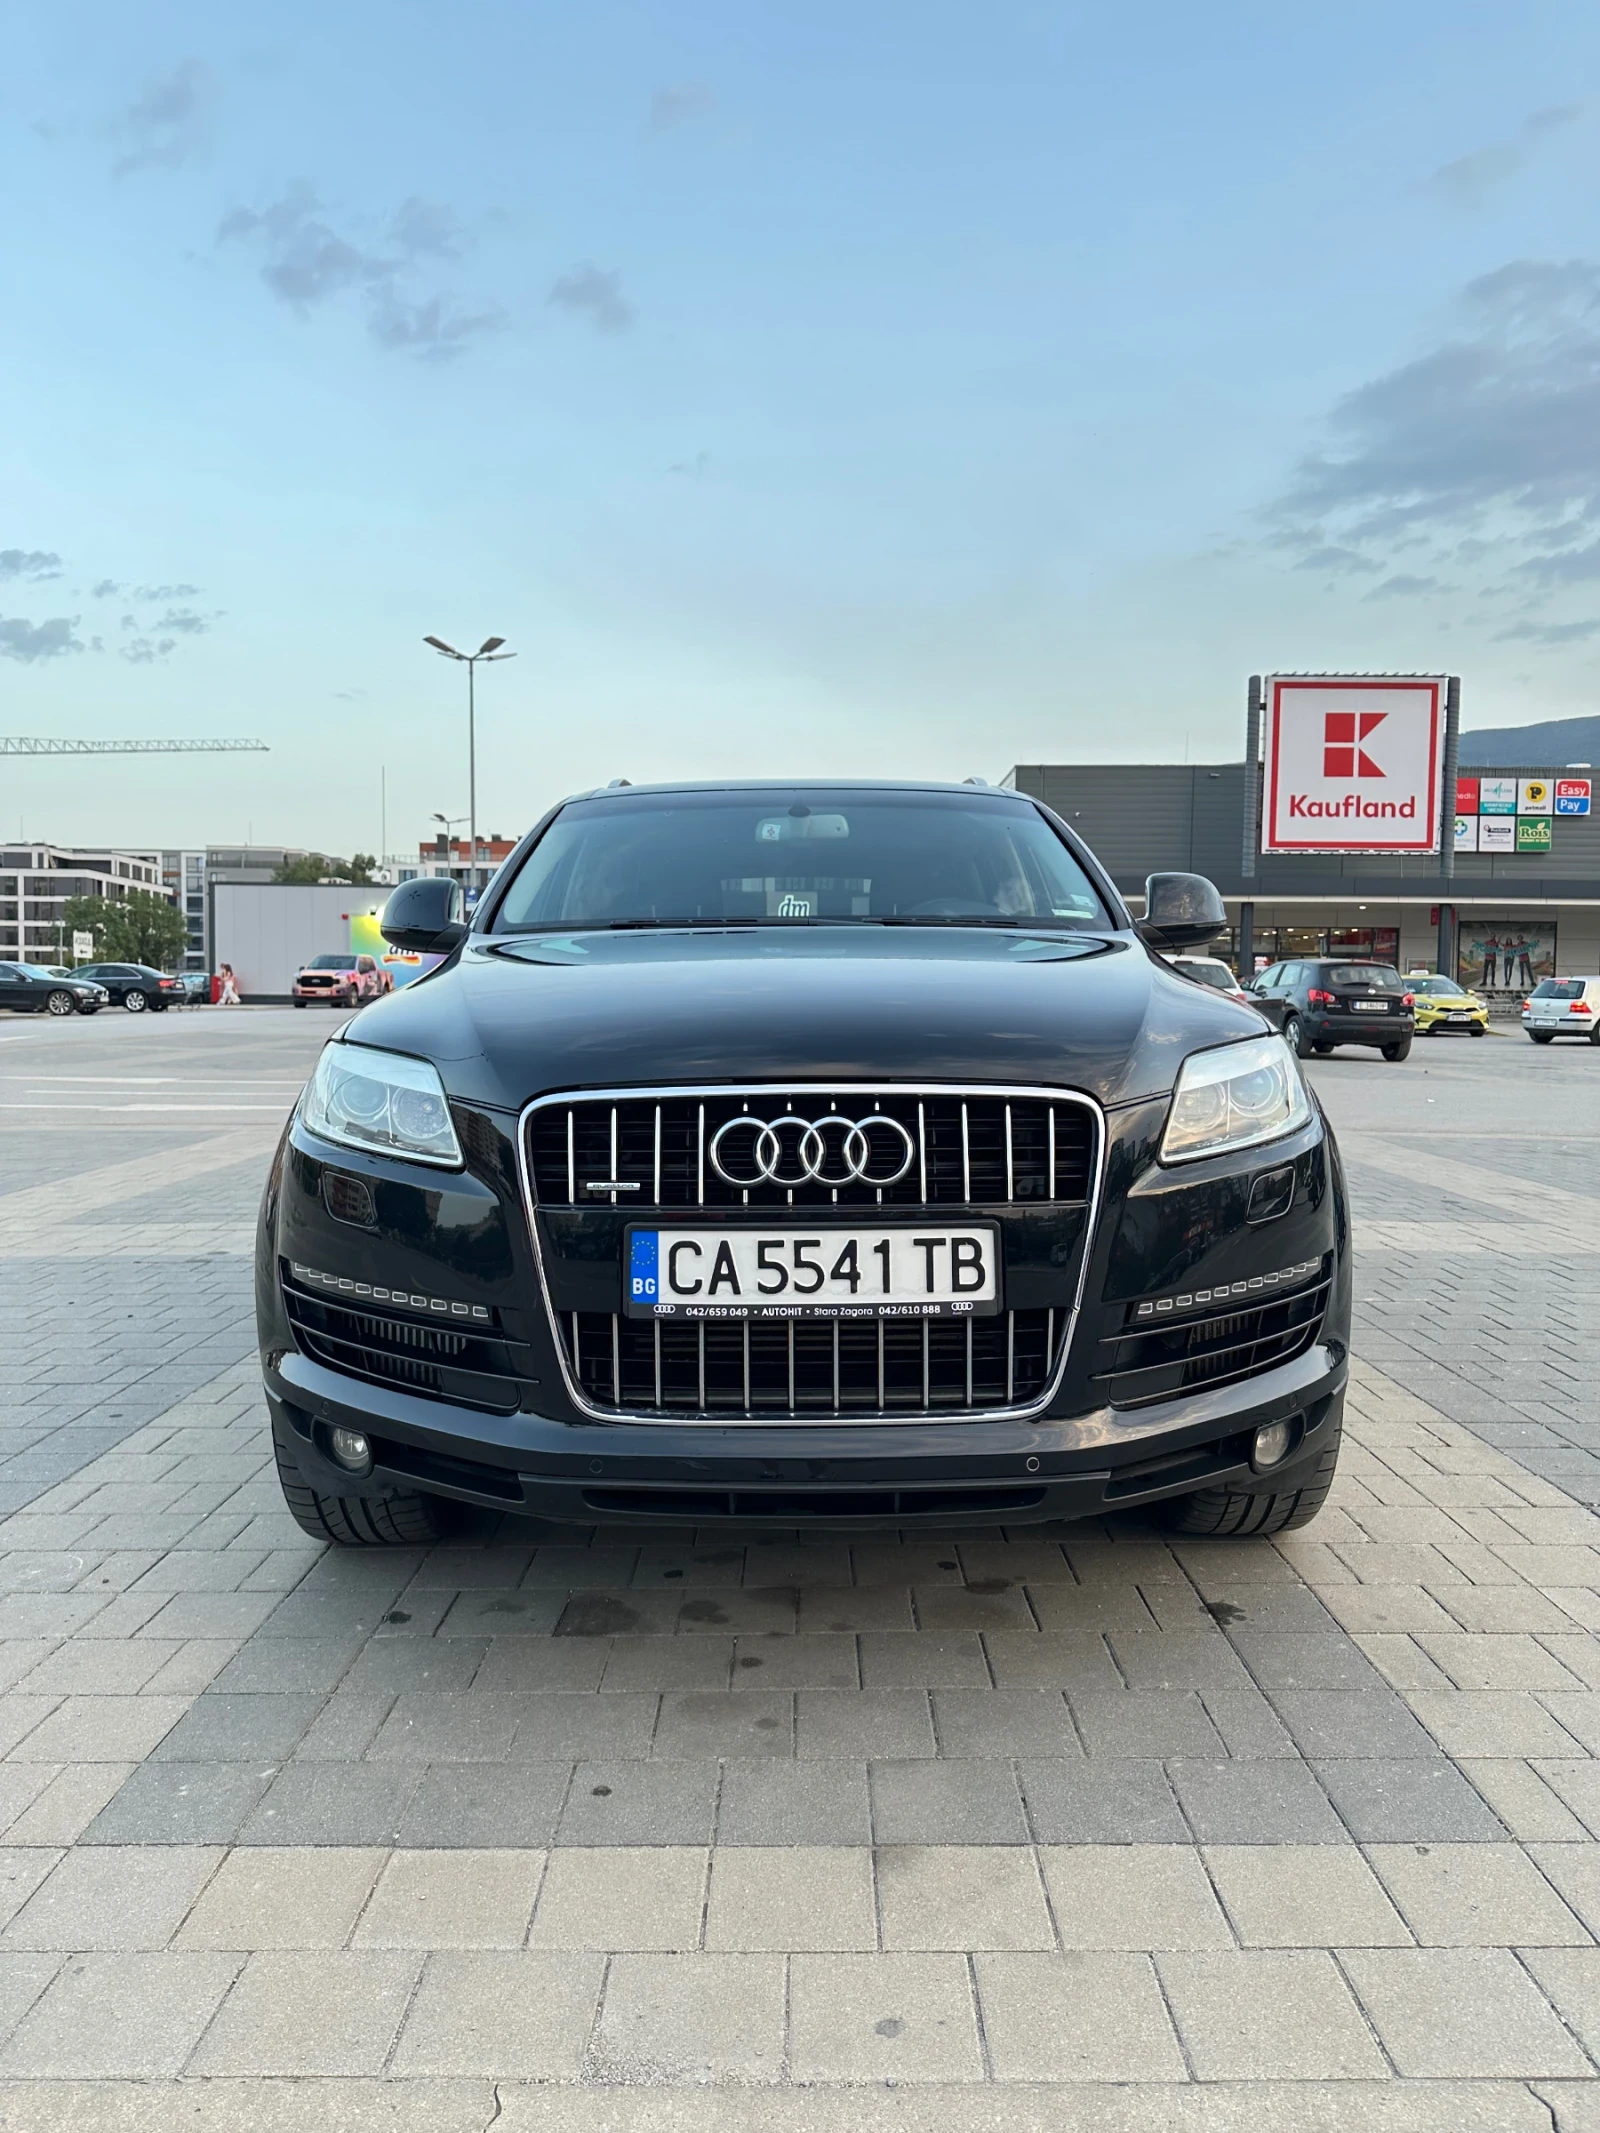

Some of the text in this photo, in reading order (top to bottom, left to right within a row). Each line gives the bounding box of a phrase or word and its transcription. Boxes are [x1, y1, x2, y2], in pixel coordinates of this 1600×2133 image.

[1560, 784, 1587, 797] Easy
[1289, 794, 1416, 818] Kaufland
[1560, 799, 1580, 812] Pay
[1520, 827, 1549, 838] Rois
[668, 1237, 986, 1295] CA 5541 TB
[632, 1277, 656, 1294] BG
[685, 1305, 941, 1317] 042/659 049 AUTOHIT Stara Zagora 042/610 888
